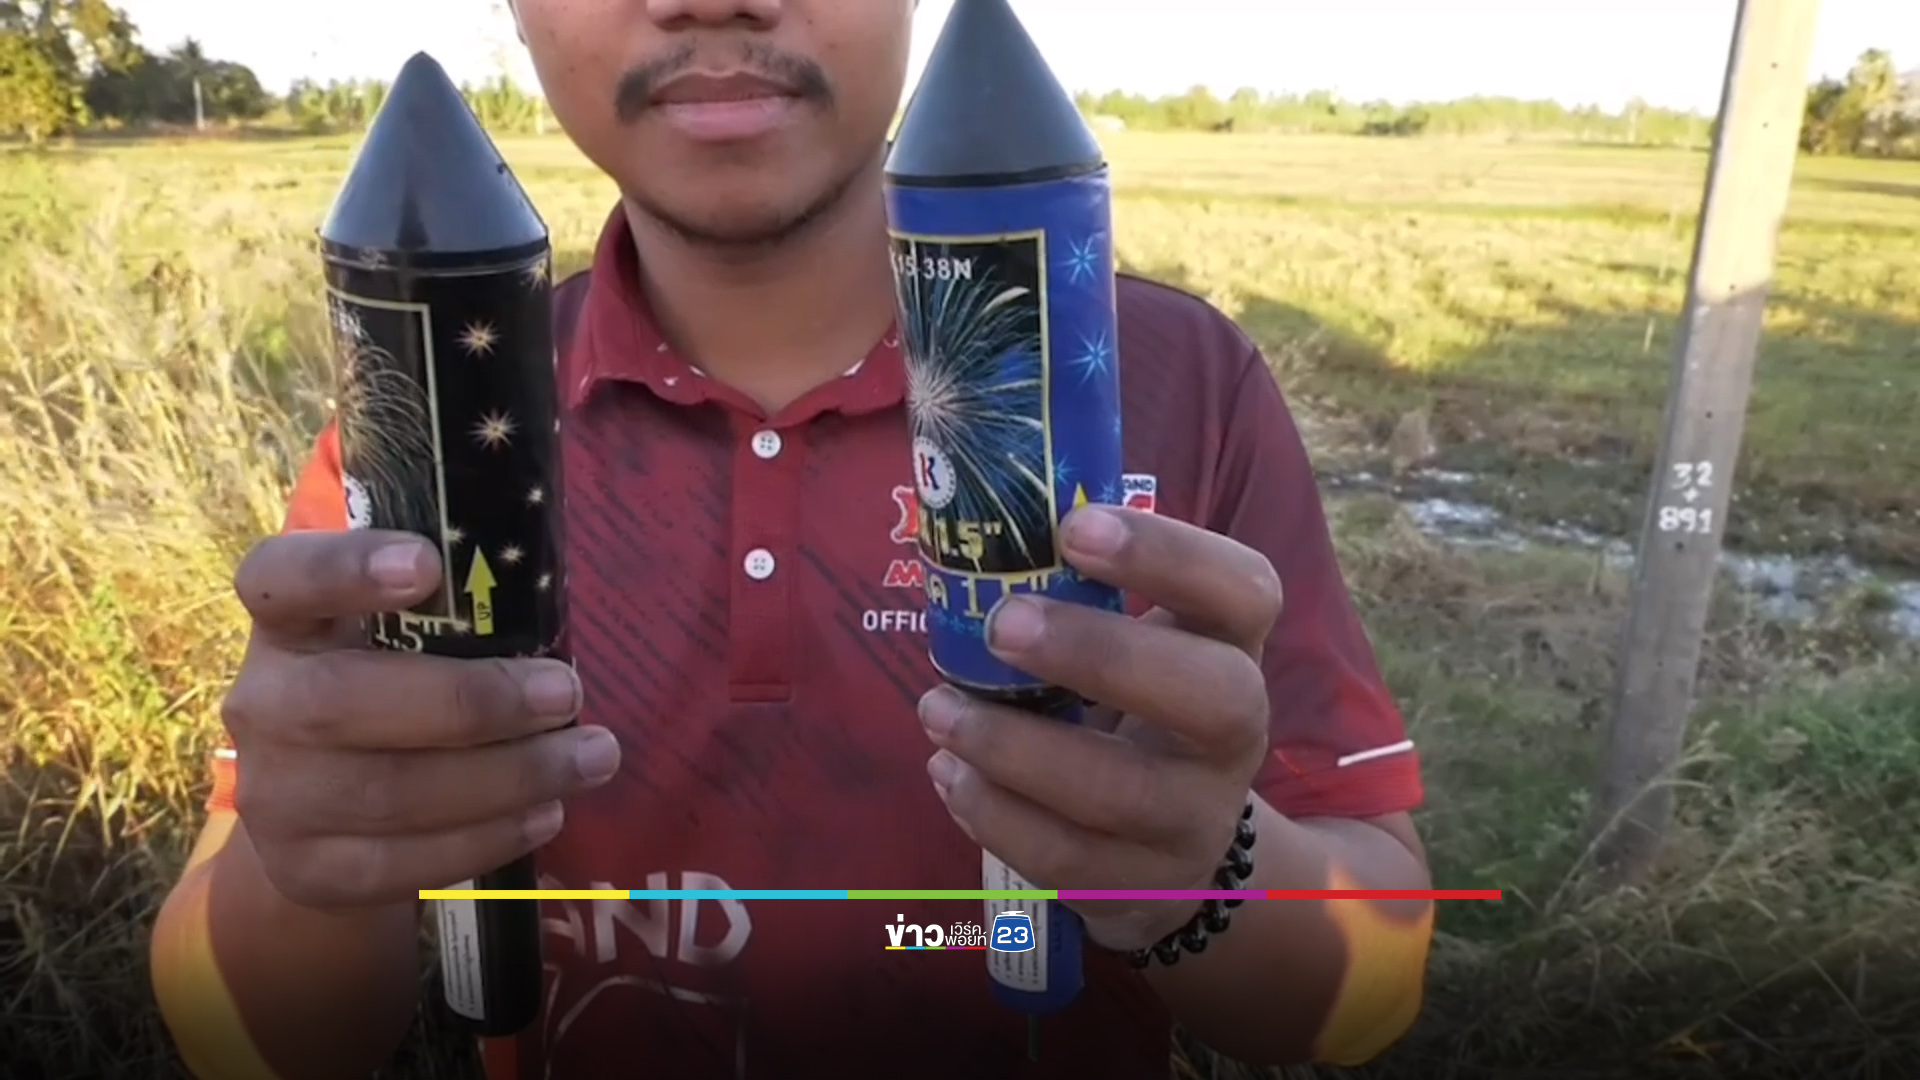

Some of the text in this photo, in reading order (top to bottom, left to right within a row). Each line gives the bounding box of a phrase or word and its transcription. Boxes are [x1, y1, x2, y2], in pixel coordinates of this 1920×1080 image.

[1671, 459, 1714, 490] 32
[1658, 505, 1714, 534] 891
[476, 601, 491, 621] UP
